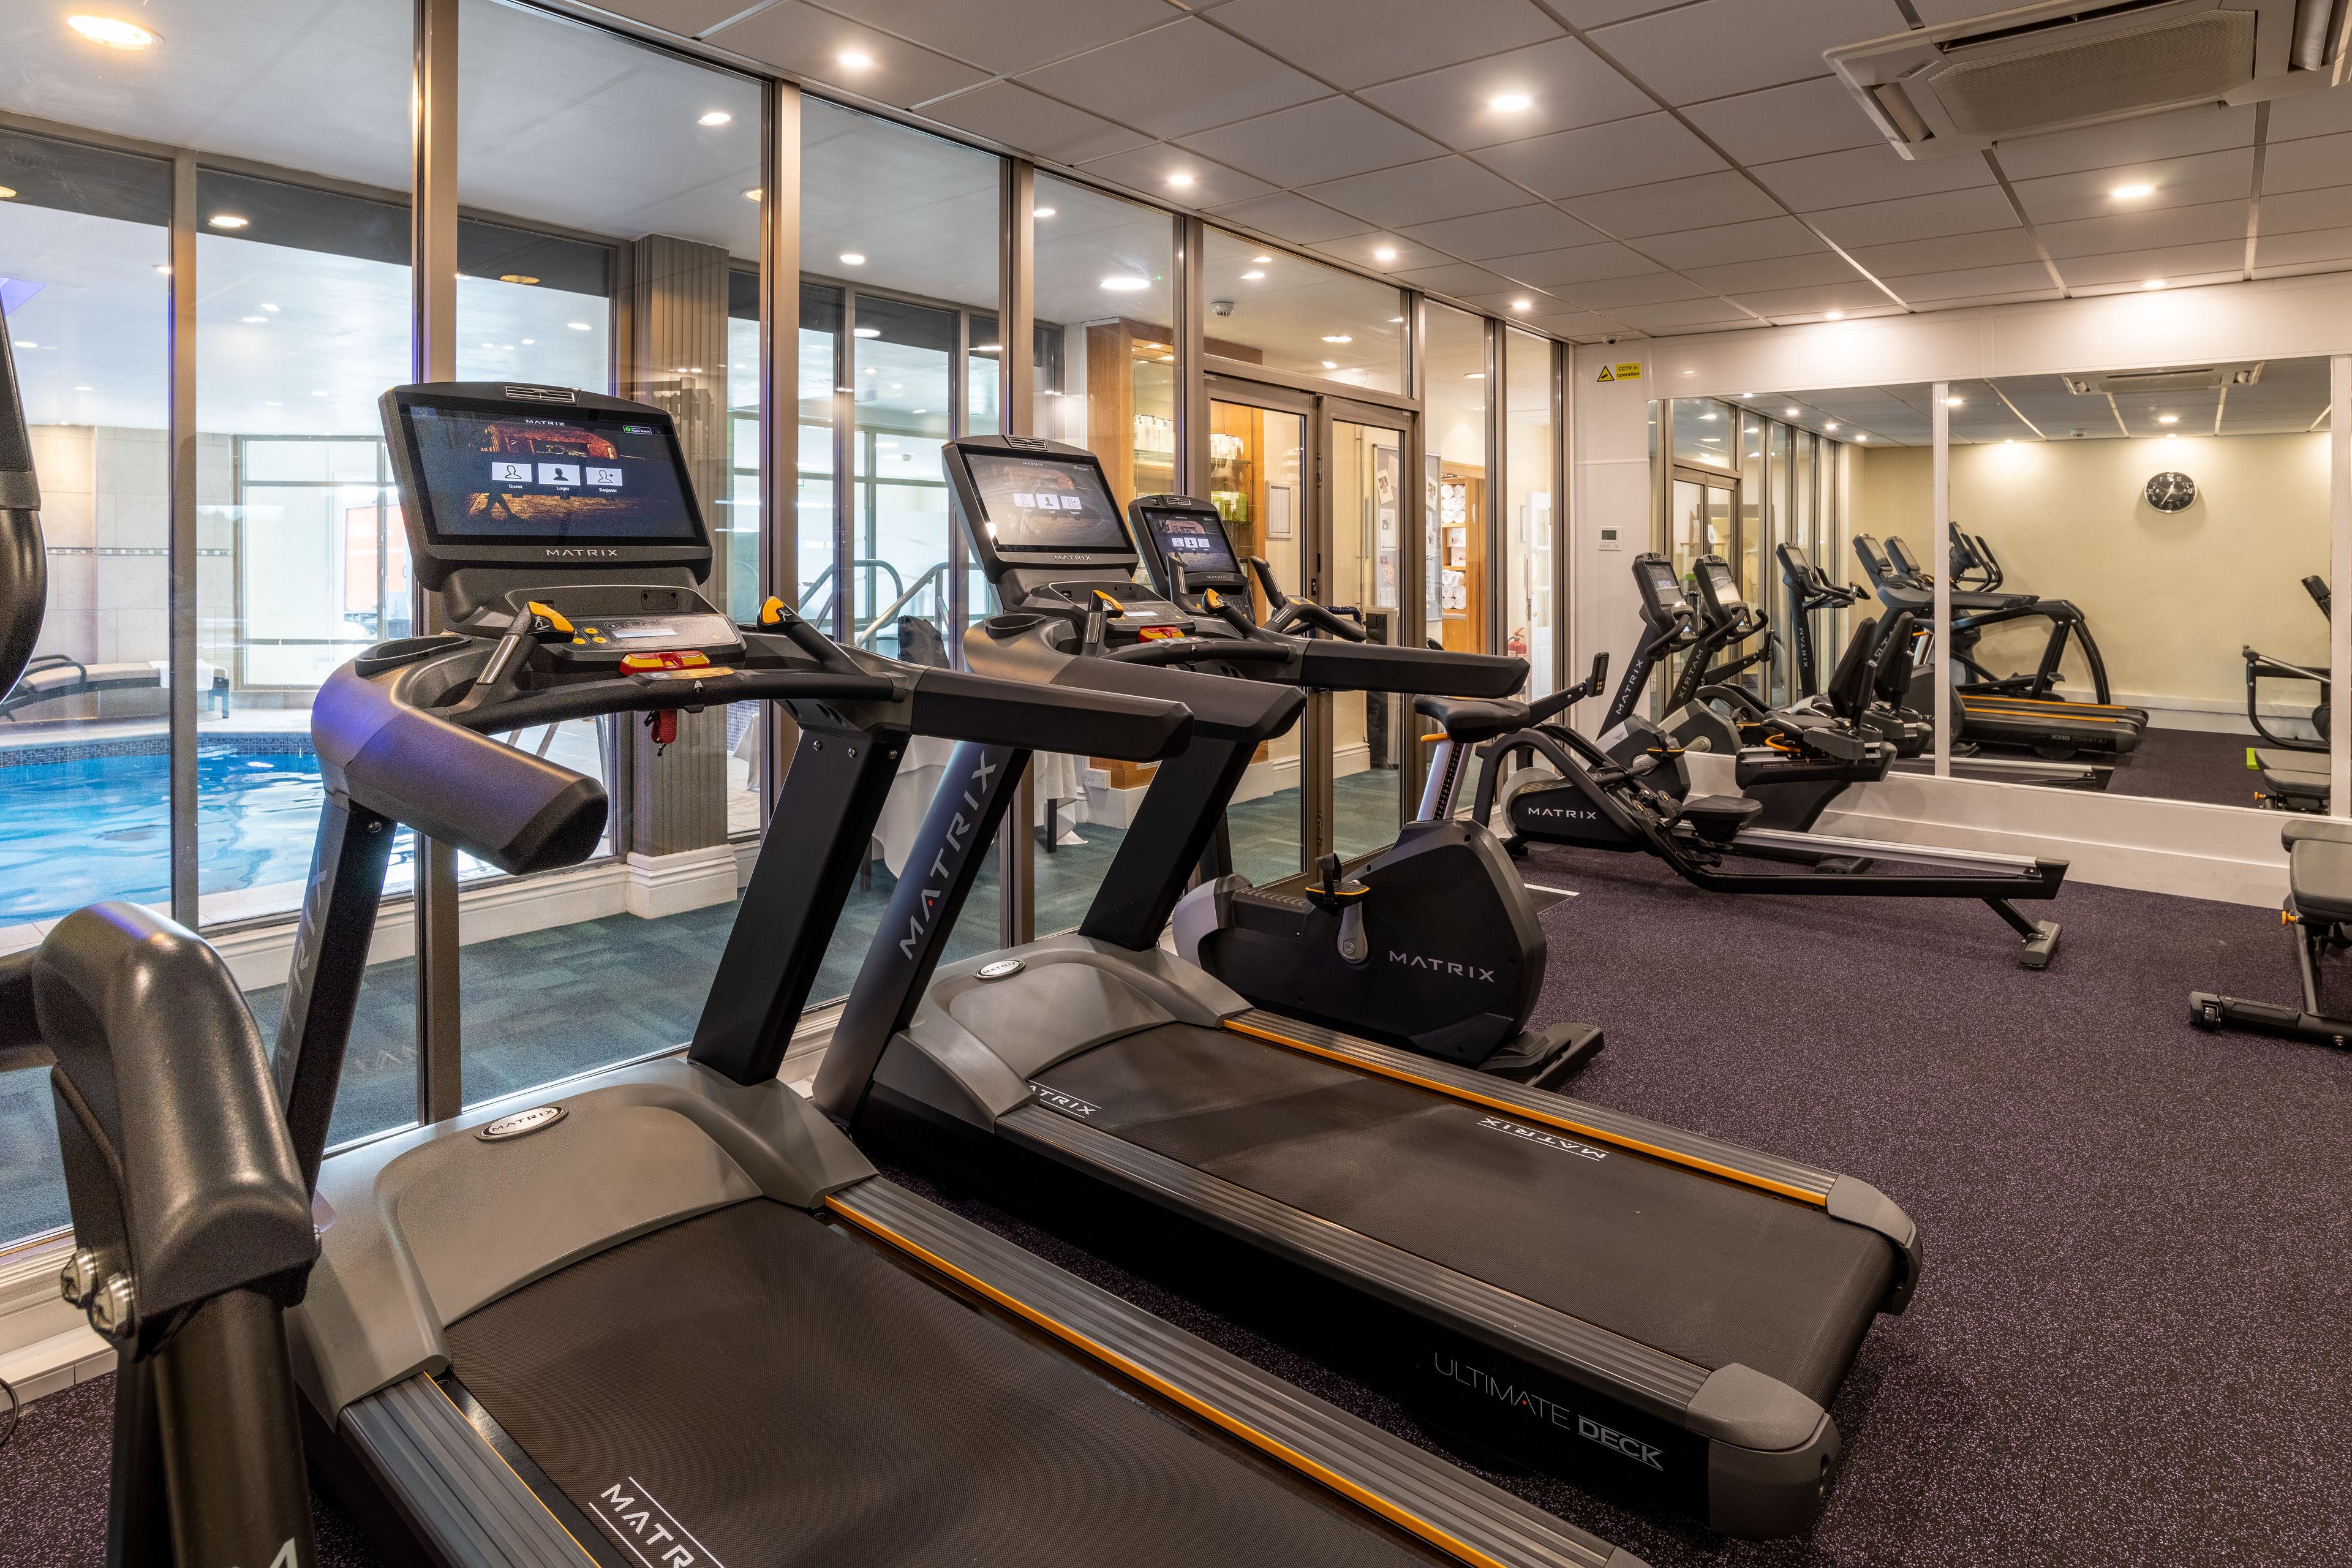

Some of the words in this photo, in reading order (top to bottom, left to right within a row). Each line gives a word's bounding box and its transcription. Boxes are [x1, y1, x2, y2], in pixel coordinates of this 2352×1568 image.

[1616, 659, 1643, 715] MATRIX
[1528, 807, 1597, 820] MATRIX
[900, 750, 997, 960] MATRIX
[274, 845, 327, 1092] ATRIX
[982, 962, 1017, 974] MATRIX
[1389, 951, 1494, 982] MATRIX
[492, 1109, 554, 1131] MATRIX
[1030, 1085, 1096, 1115] ATRIX
[1480, 1118, 1607, 1158] MATRIX
[1435, 1352, 1570, 1430] ULTIMATE
[1578, 1415, 1663, 1471] DECK
[601, 1483, 694, 1568] MATR
